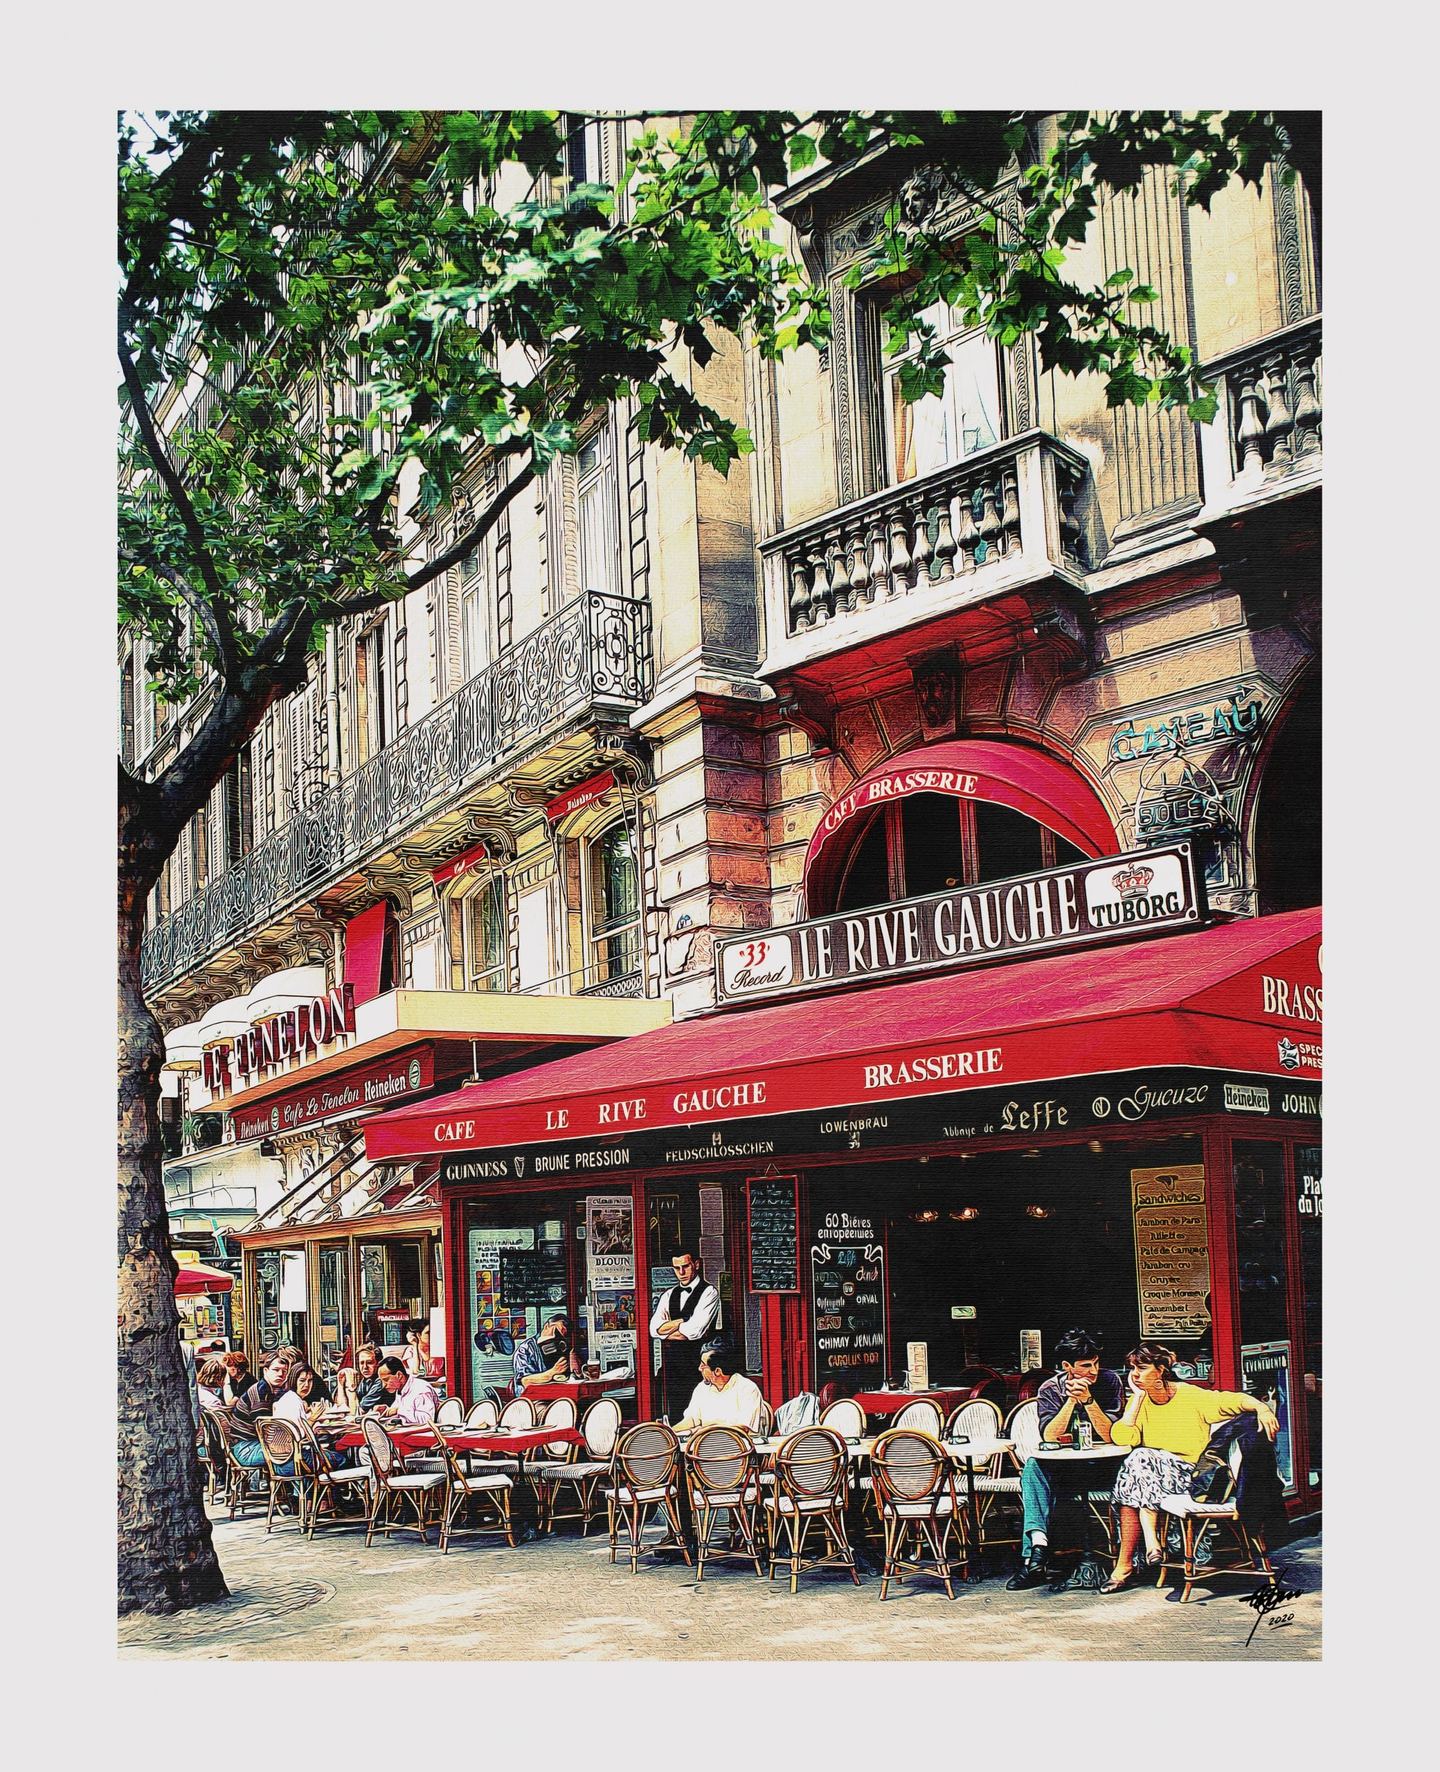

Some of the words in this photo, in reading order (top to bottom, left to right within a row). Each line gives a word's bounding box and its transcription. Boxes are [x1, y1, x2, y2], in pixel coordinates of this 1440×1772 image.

[1111, 700, 1263, 760] CAVEAU
[868, 771, 979, 800] BRASSERIE
[1091, 891, 1180, 927] TUBORG
[799, 925, 834, 981] LE
[843, 907, 921, 972] RIVE
[934, 874, 1081, 956] GAUCHE
[731, 965, 787, 990] Record
[233, 984, 347, 1078] FENELON
[864, 1048, 1003, 1089] BRASSERIE
[306, 1098, 319, 1117] Le
[364, 1073, 407, 1101] Heineken
[1225, 1085, 1268, 1109] Heineken
[1282, 1094, 1317, 1115] JOHN
[434, 1120, 476, 1142] CAFE
[546, 1110, 569, 1130] LE
[598, 1099, 647, 1124] RIVE
[672, 1082, 767, 1114] GAUCHE
[943, 1125, 976, 1138] Abbaye
[983, 1123, 994, 1133] de
[1000, 1100, 1069, 1132] Leffe
[446, 1160, 508, 1181] GUINNESS
[535, 1154, 570, 1173] BRUNE
[575, 1148, 630, 1169] PRESSION
[1138, 1192, 1201, 1205] Sandwiches
[1298, 1194, 1313, 1213] du
[825, 1212, 840, 1228] 60
[856, 1294, 879, 1305] ORVAL
[818, 1336, 850, 1350] CHIMAY
